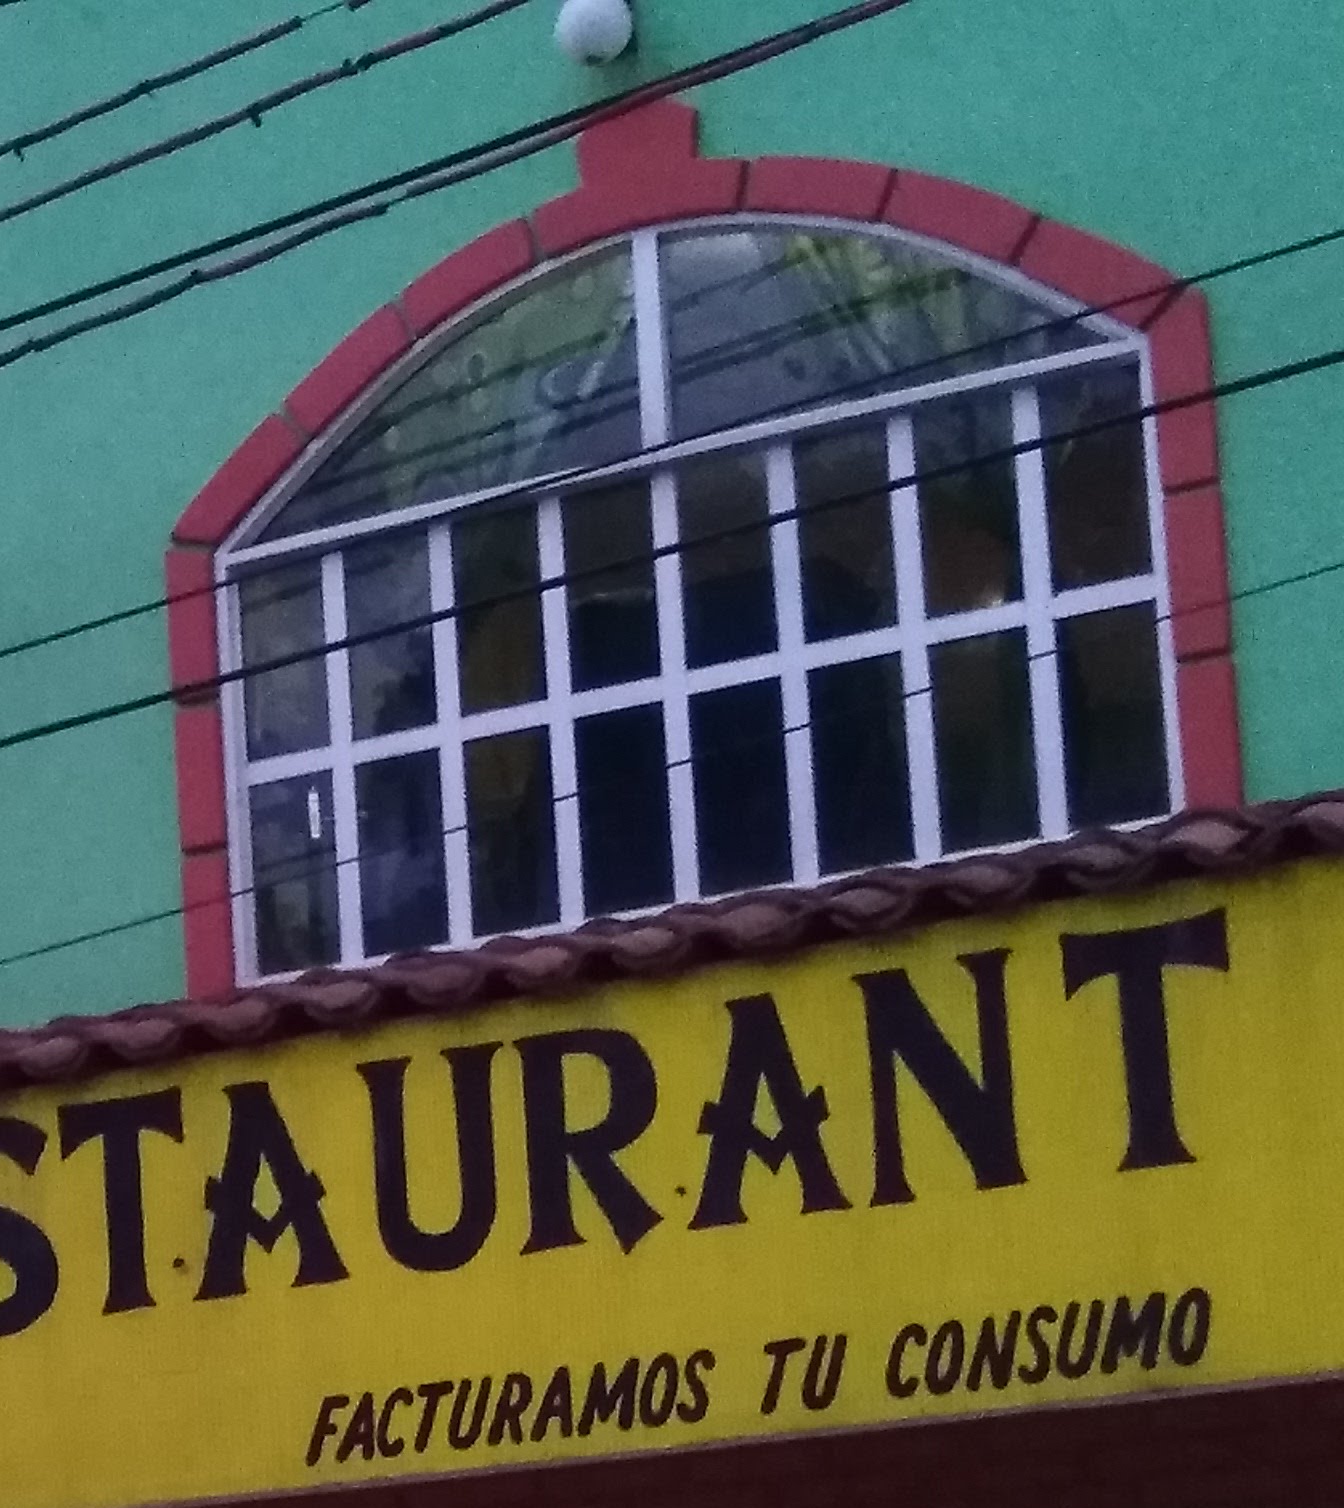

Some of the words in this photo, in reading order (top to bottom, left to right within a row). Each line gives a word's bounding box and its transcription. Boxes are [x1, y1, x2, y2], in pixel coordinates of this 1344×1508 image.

[304, 1344, 718, 1467] FACTURAMOS
[762, 1330, 846, 1414] TU
[884, 1288, 1212, 1396] CONSUMO
